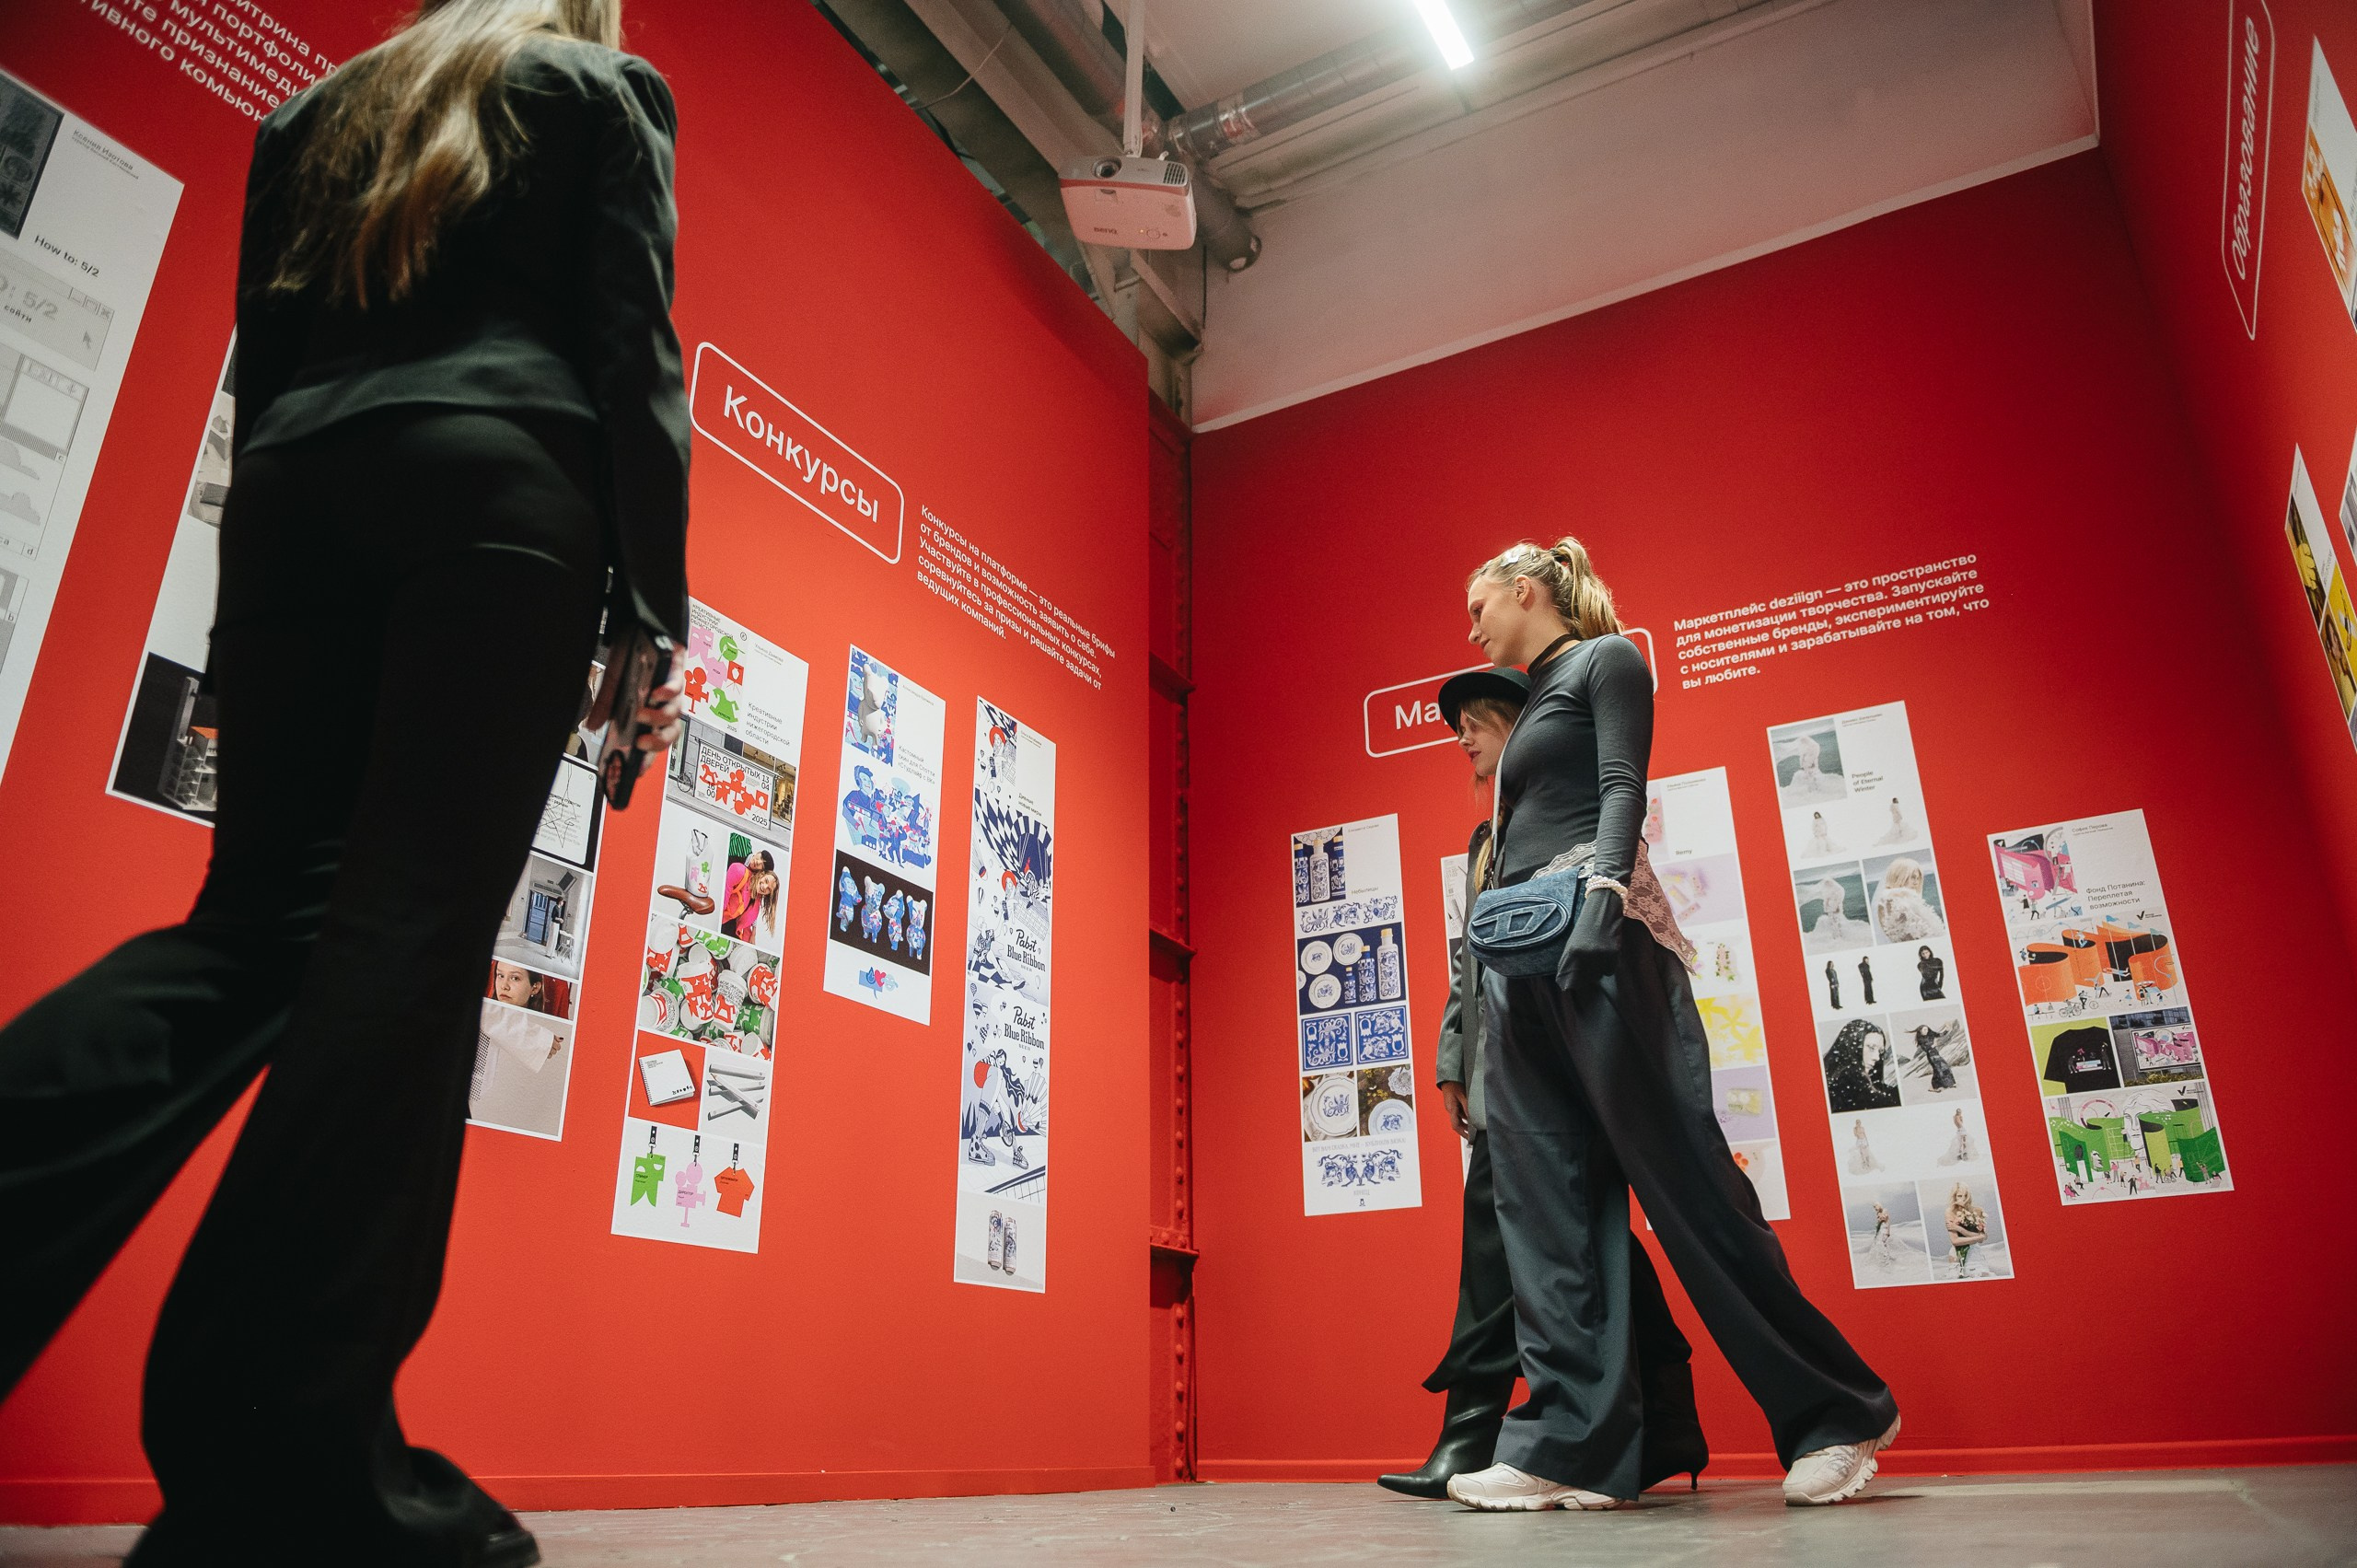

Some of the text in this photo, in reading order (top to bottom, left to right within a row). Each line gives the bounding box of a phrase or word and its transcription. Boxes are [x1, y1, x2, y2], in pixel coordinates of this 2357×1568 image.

[213, 4, 317, 86] портфоли
[230, 0, 310, 57] итрина
[81, 0, 267, 122] ивного комьюн
[162, 19, 280, 108] признание
[2232, 14, 2259, 280] Образование
[34, 235, 100, 278] How to: 5/2
[724, 384, 878, 523] Конкурсы
[920, 523, 1097, 659] от брендов и возможность заявить о себе.
[922, 505, 967, 548] Конкурсы
[969, 542, 980, 557] на
[981, 552, 1028, 592] платформе
[1039, 596, 1052, 610] это
[1053, 606, 1090, 639] реальные
[1091, 633, 1116, 658] брифы
[1674, 602, 1767, 632] Маркетплейс
[1769, 589, 1823, 610] deziiign
[1844, 578, 1869, 593] это
[1872, 553, 1977, 587] пространство
[917, 571, 1006, 640] ведущих компаний.
[919, 535, 1102, 679] Участвуйте в профессиональных конкурсах,
[1676, 569, 1978, 647] для монетизации творчества. Запускайте
[1678, 584, 1984, 660] собственные бренды, экспериментируйте
[918, 555, 1102, 691] соревнуйтесь за призы и решайте задачи от
[1680, 598, 1990, 675] с носителями и зарабатывайте на том, что
[1682, 665, 1761, 690] вы любите.
[747, 712, 778, 731] индустрии
[748, 702, 783, 725] Креативные
[1395, 700, 1448, 730] Ма
[745, 729, 770, 746] области
[746, 720, 790, 747] нижегородской
[700, 755, 730, 773] ДВЕРЕЙ
[701, 746, 722, 761] ДЕНЬ
[722, 756, 761, 780] ОТКРЫТЫХ
[1852, 771, 1874, 779] People
[751, 813, 768, 827] 2025
[2085, 880, 2146, 895] Фонд Потанина:
[2087, 890, 2133, 902] Переплетая
[2089, 898, 2141, 911] возможности
[1016, 928, 1038, 953] Pabst
[1006, 944, 1046, 972] Blue Ribbon
[1013, 1005, 1036, 1030] Pabst
[1004, 1023, 1045, 1051] Blue Ribbon
